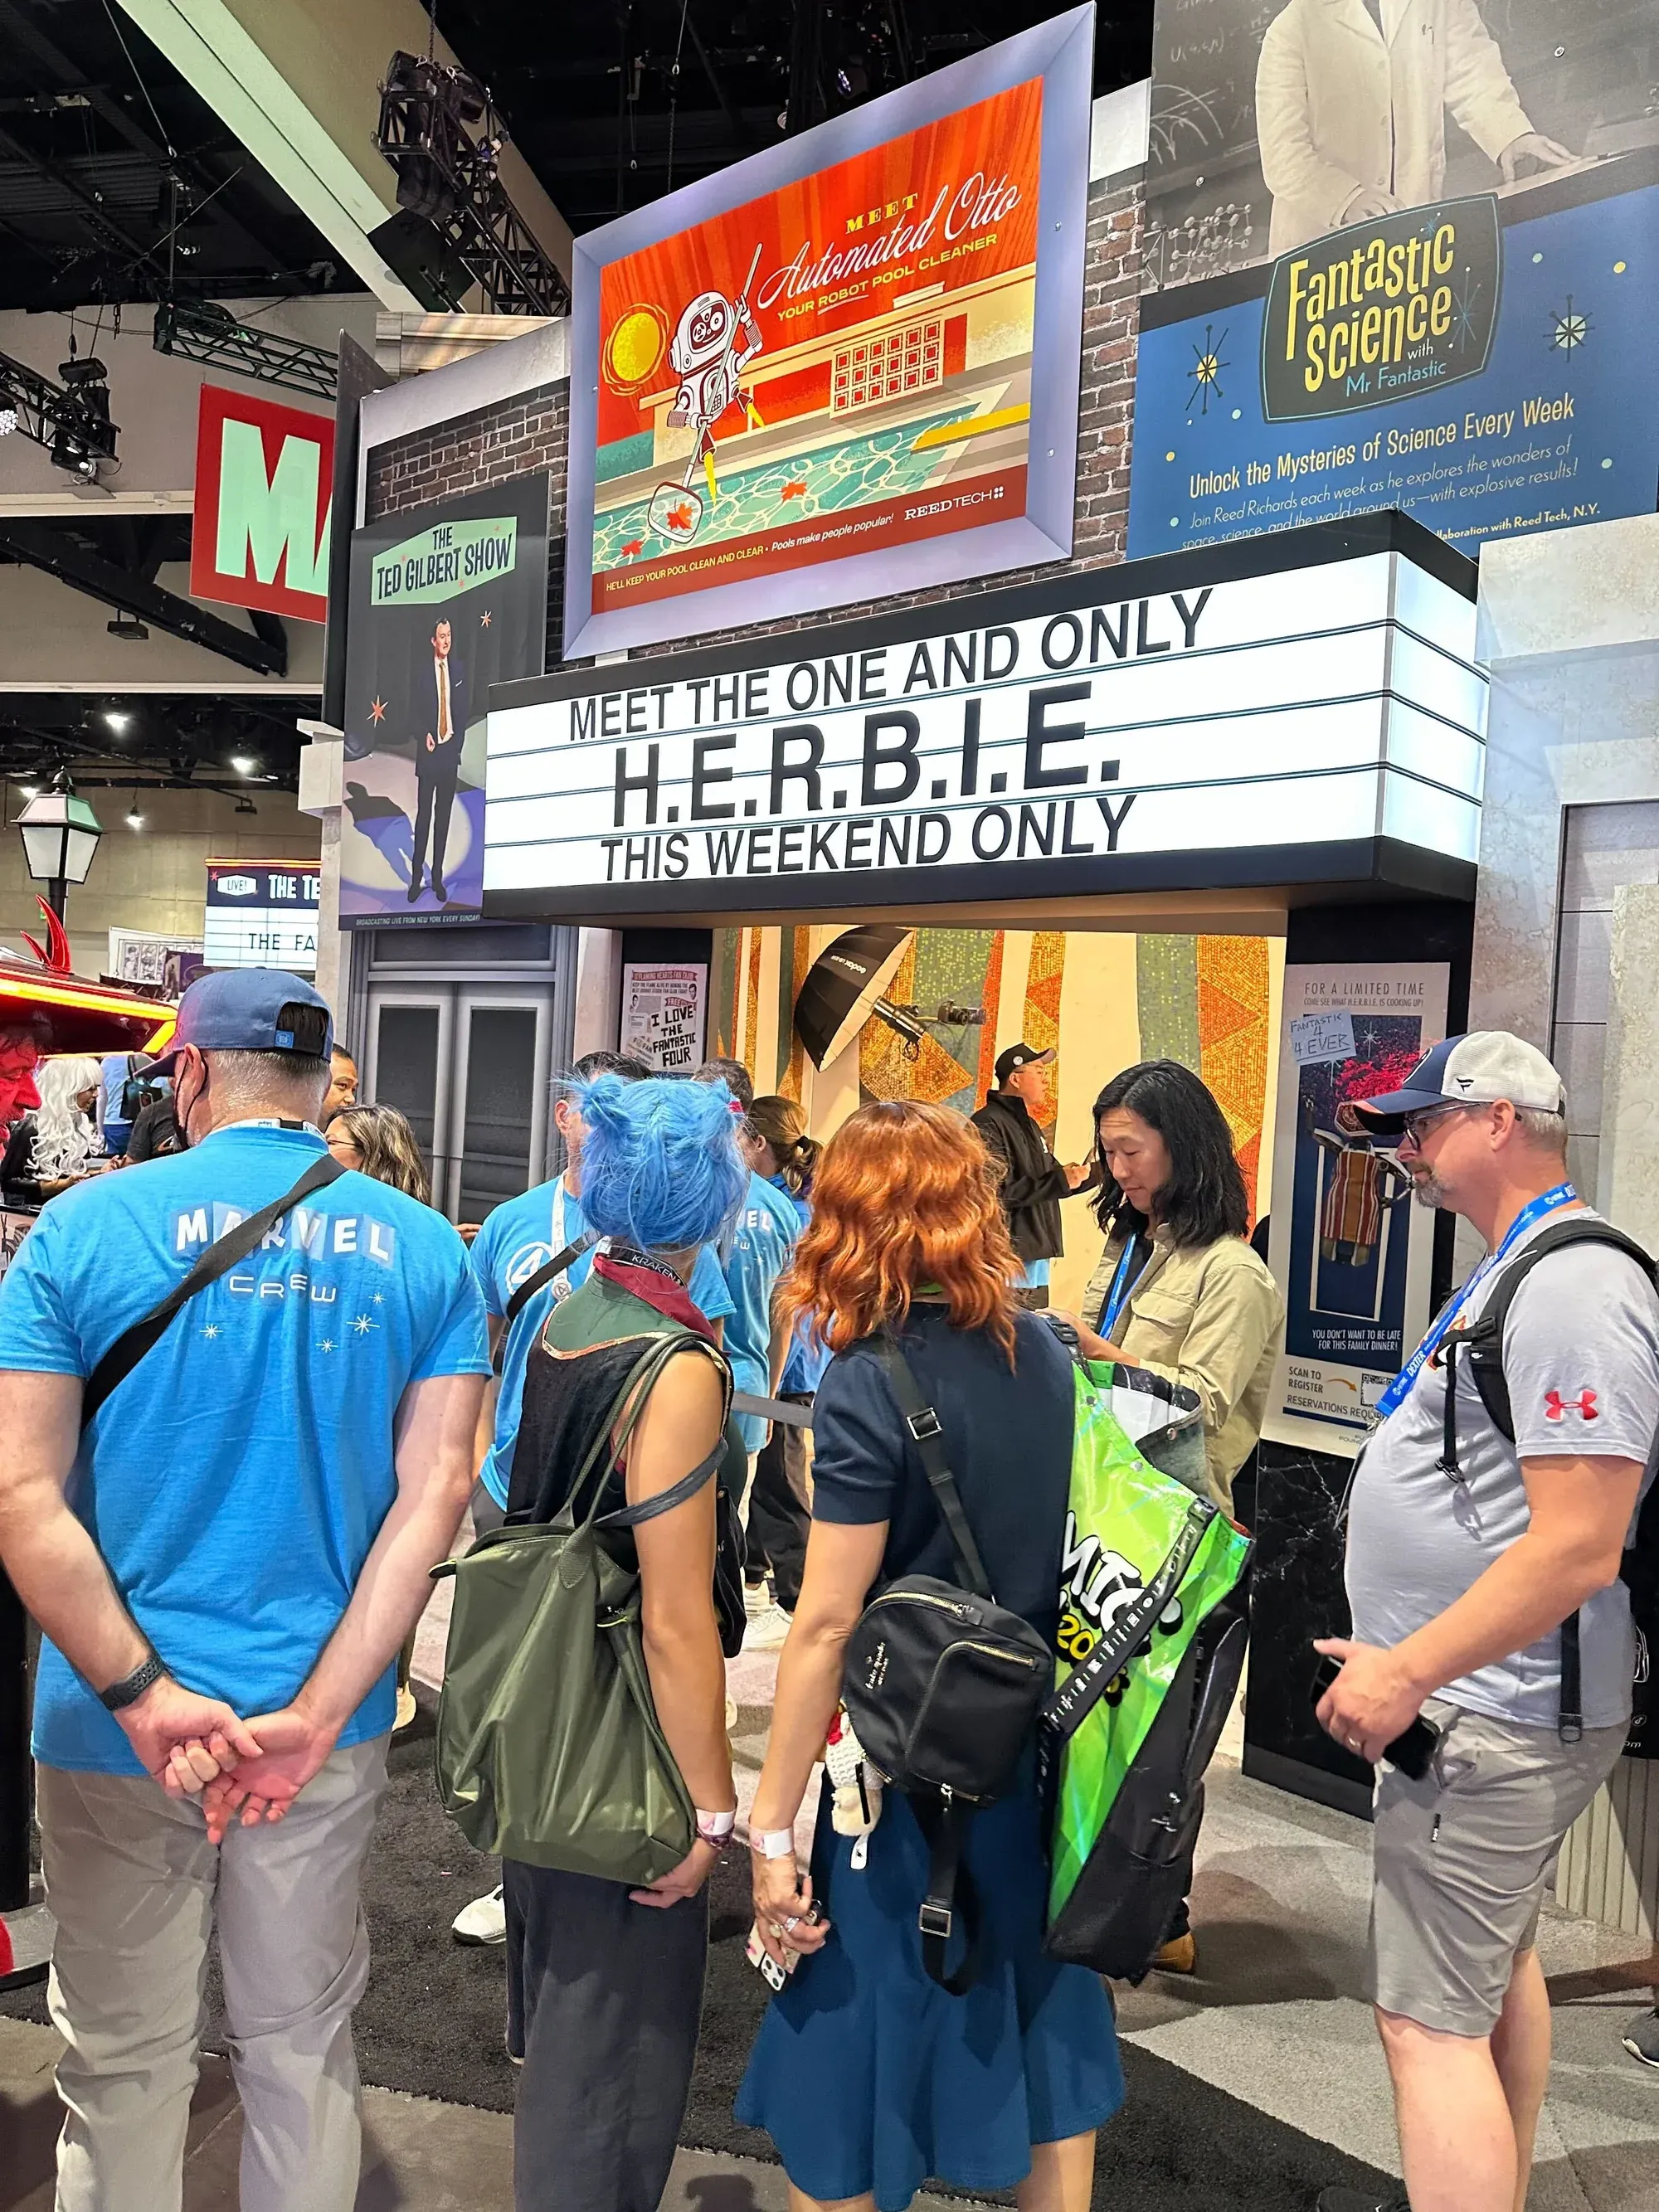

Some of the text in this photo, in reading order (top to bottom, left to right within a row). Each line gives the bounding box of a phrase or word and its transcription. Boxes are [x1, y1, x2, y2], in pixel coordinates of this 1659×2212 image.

[845, 192, 918, 235] MEET
[757, 172, 1023, 310] Automated Otto
[777, 233, 998, 322] YOUR ROBOT POOL CLEANER
[1286, 223, 1456, 361] Fantastic
[1408, 338, 1433, 360] with
[1346, 360, 1447, 397] Mr Fantastic
[1190, 392, 1575, 498] Unlock the Mysteries of Science Every Week
[1190, 434, 1573, 529] Join Reed Richards each week as he explores the wonders of
[1267, 508, 1294, 532] and
[1296, 507, 1313, 528] the
[1316, 501, 1350, 521] world
[1459, 474, 1525, 499] explosive
[1528, 457, 1579, 484] results!
[1491, 516, 1512, 532] with
[1514, 512, 1542, 528] Reed
[1544, 508, 1571, 523] Tech,
[1573, 503, 1601, 518] N.Y.
[432, 526, 453, 551] THE
[606, 513, 894, 591] HE'LL KEEP YOUR POOL CLEAN AND CLEAR Pools make people popular!
[377, 532, 513, 600] TED GILBERT SHOW
[570, 587, 1214, 741] MEET THE ONE AND ONLY
[613, 681, 1121, 828] H.E.R.B.I.E.
[601, 794, 1137, 881] THIS WEEKEND ONLY
[227, 879, 247, 892] LIVE!
[268, 874, 297, 900] THE
[356, 917, 390, 926] BROADCASTING
[416, 916, 428, 924] NEW
[248, 933, 317, 951] THE FA
[657, 971, 673, 980] HEARTS
[673, 971, 682, 980] FAN
[1305, 982, 1424, 995] FOR A LIMITED TIME
[667, 998, 681, 1006] FREE
[1304, 998, 1423, 1007] COME SEE WHAT H.E.R.B.I.E. IS COOKING UP!
[651, 1014, 659, 1027] I
[664, 1004, 693, 1024] LOVE
[661, 1023, 683, 1037] THE
[1313, 1025, 1324, 1036] 4
[653, 1033, 696, 1053] FANTASTIC
[1294, 1033, 1350, 1057] 4 EVER
[662, 1047, 692, 1067] FOUR
[631, 1254, 675, 1281] KRAKEN
[229, 1273, 336, 1303] CREW
[1312, 1330, 1401, 1339] YOU DON'T WANT TO BE LATE
[1318, 1340, 1398, 1350] FOR THIS FAMILY DINNER!
[1288, 1366, 1321, 1380] SCAN TO
[1406, 1350, 1426, 1377] DEXTER
[1288, 1379, 1324, 1393] REGISTER
[1287, 1394, 1348, 1415] RESERVATIONS
